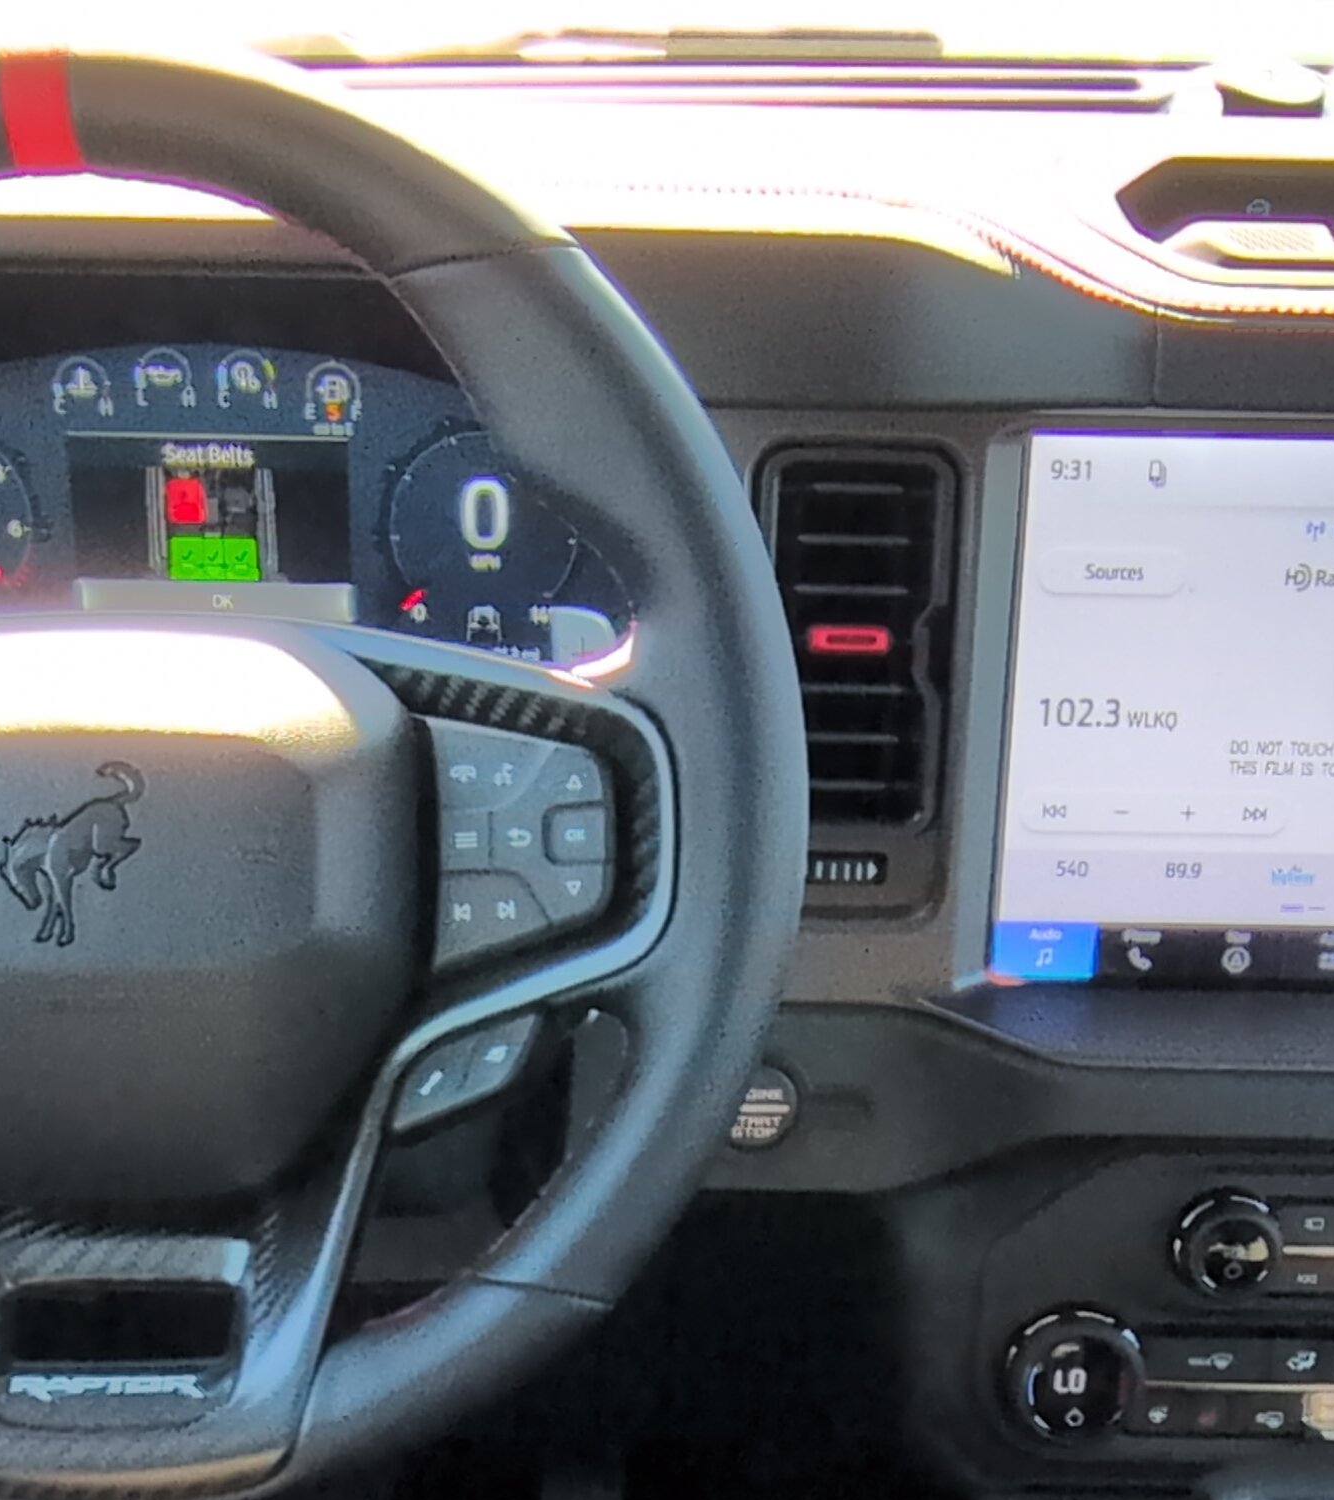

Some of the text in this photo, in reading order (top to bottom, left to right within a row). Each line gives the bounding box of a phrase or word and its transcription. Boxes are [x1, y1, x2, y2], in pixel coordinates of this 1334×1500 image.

[161, 443, 255, 468] Seat Belts
[1050, 458, 1093, 481] 9:31
[460, 475, 510, 551] 0
[1084, 563, 1144, 582] Sources
[212, 595, 234, 609] OK
[1039, 698, 1178, 731] 102.3 WLKQ
[1230, 740, 1249, 755] DO
[1257, 741, 1283, 756] NOT
[1291, 742, 1334, 757] TOUCH
[1230, 761, 1258, 775] THIS
[1267, 761, 1294, 776] FILM
[1302, 762, 1313, 777] IS
[1056, 860, 1090, 878] 540
[1166, 863, 1202, 880] 89.9
[1029, 928, 1063, 941] Audio
[8, 1374, 207, 1402] RAPTOR
